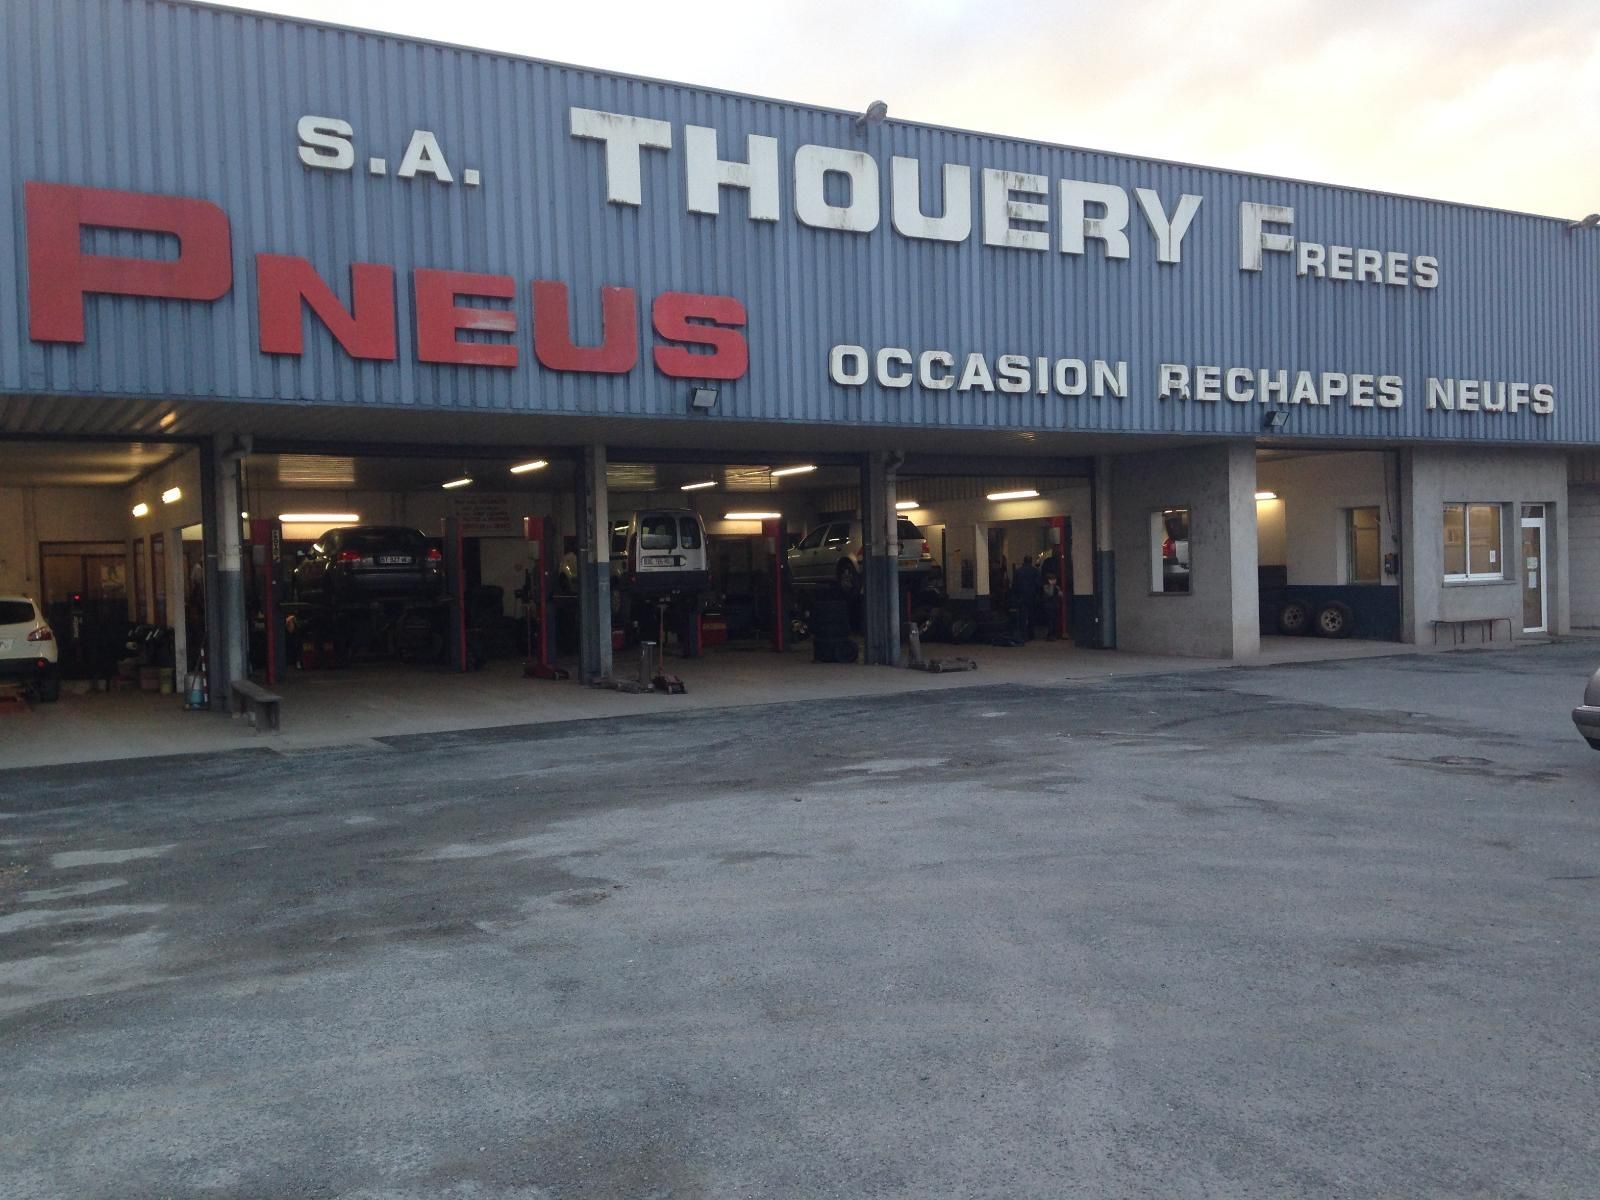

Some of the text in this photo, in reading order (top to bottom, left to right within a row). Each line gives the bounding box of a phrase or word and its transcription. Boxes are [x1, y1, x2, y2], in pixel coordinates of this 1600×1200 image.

[25, 181, 749, 380] PNEUS
[297, 108, 1439, 289] S.A. THOUERY FRERES
[829, 344, 1555, 415] OCCASION RECHAPES NEUFS
